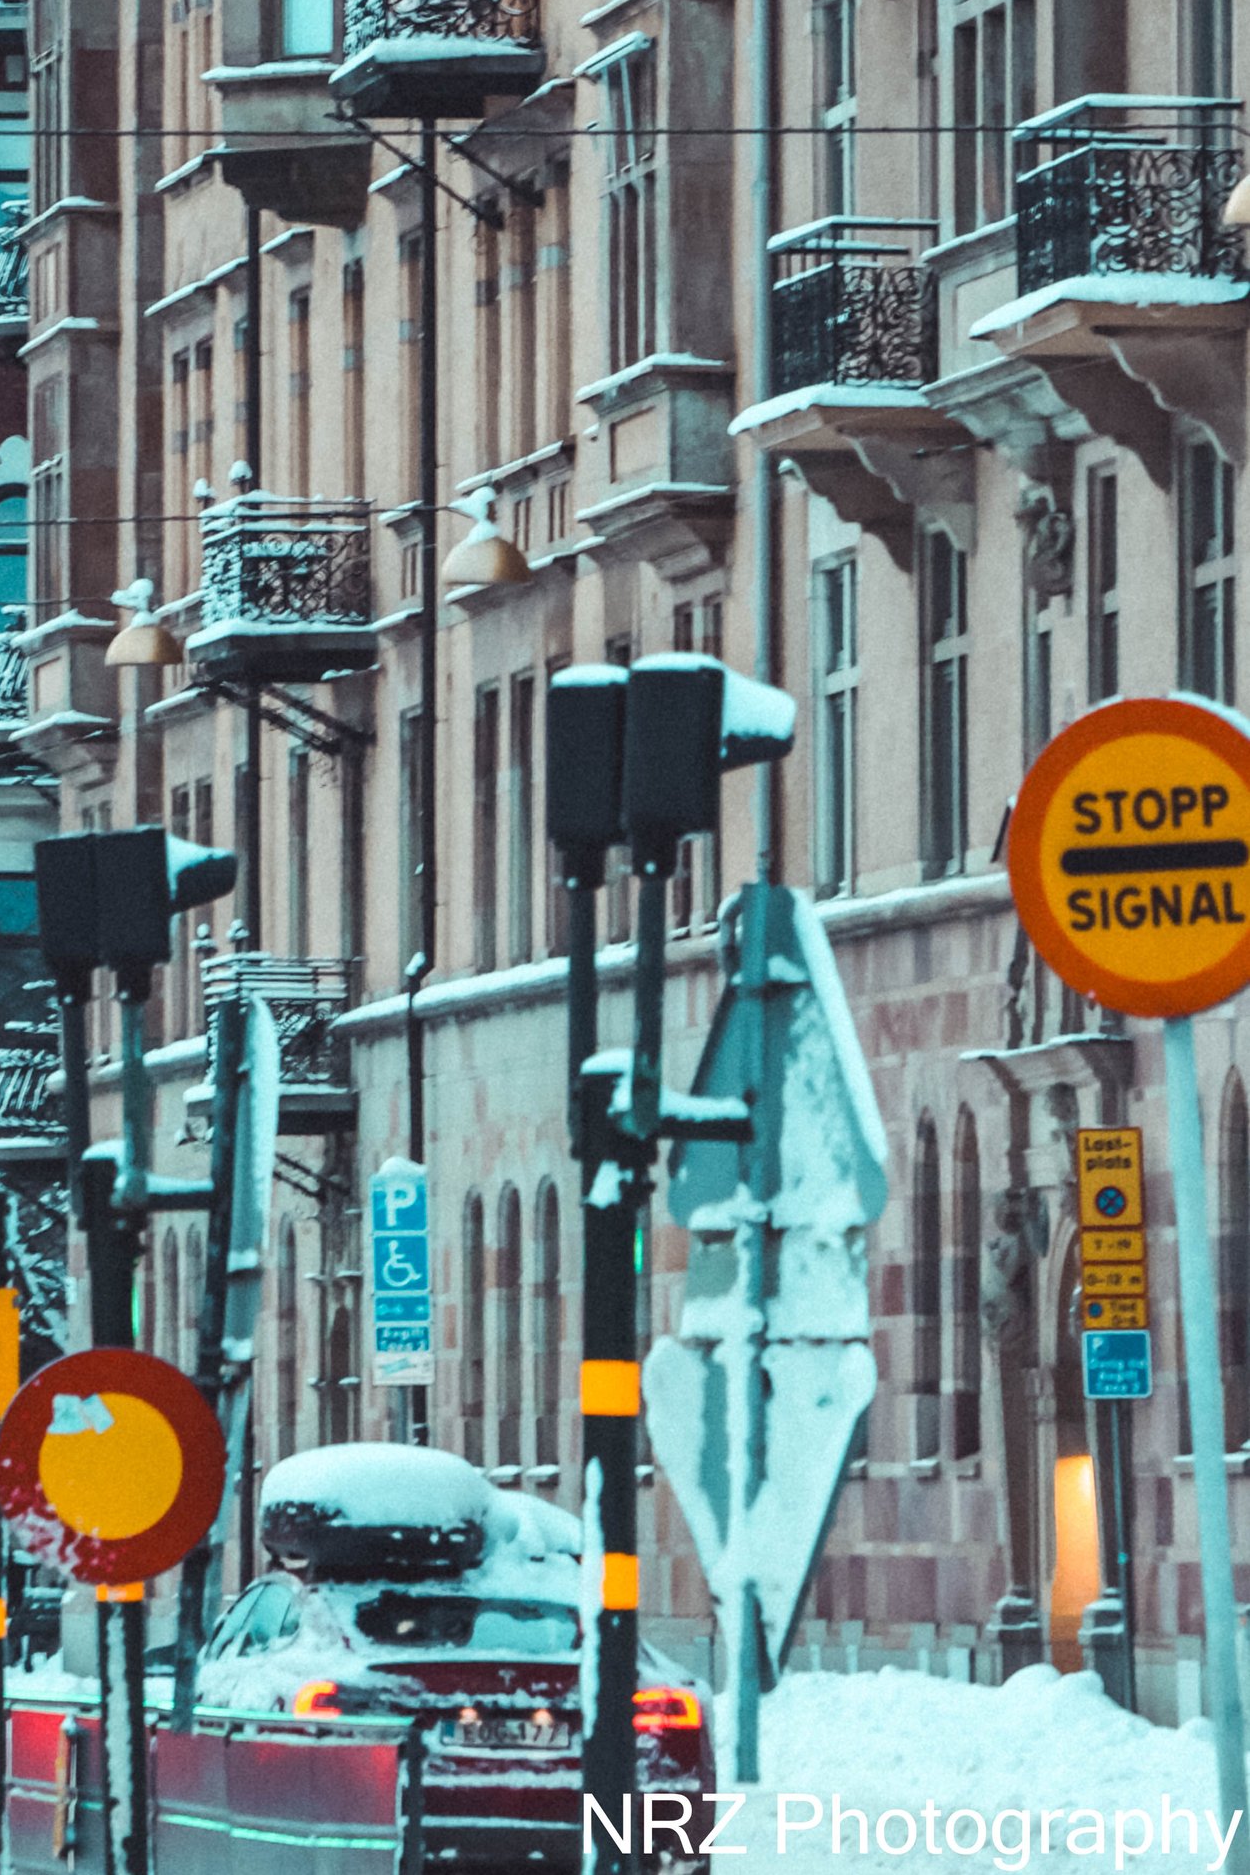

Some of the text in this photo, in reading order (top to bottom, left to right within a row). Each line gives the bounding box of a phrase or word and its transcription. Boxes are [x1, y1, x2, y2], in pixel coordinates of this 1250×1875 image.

[1072, 784, 1229, 834] STOPP
[1067, 881, 1245, 931] SIGNAL
[385, 1181, 416, 1227] P
